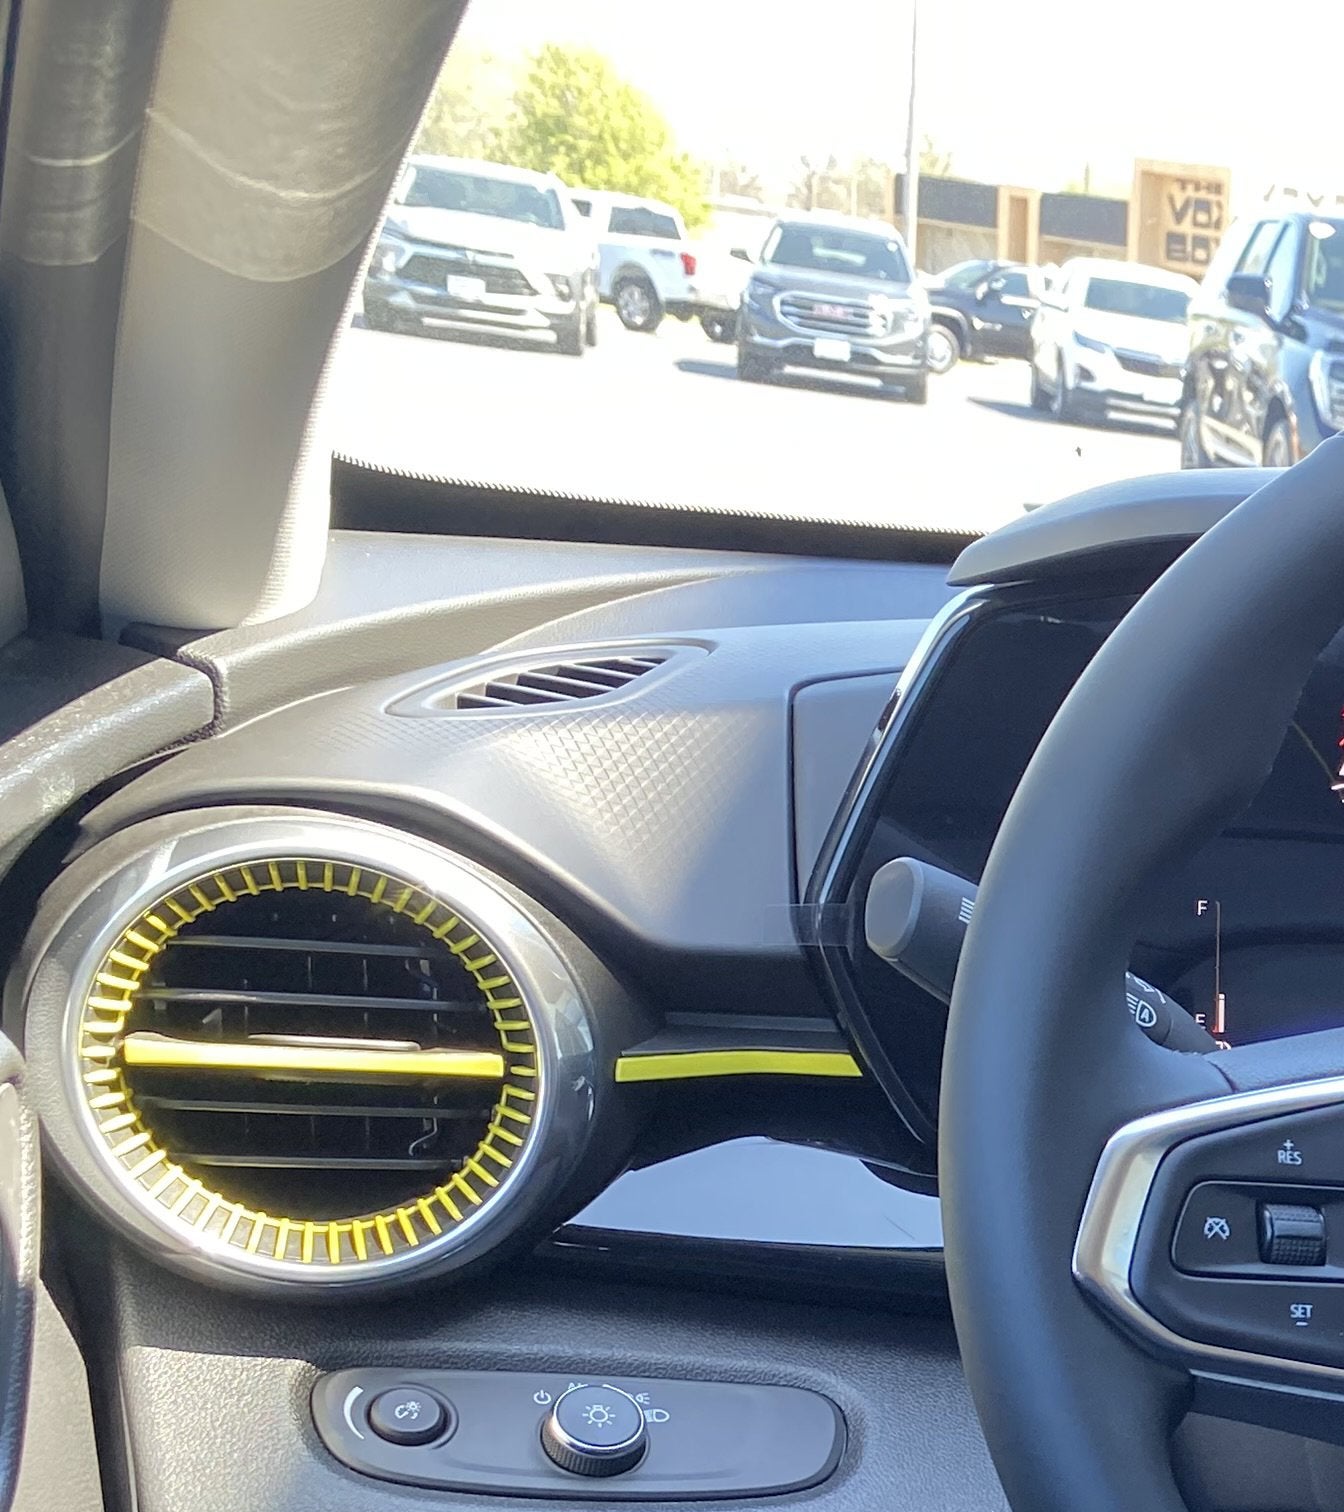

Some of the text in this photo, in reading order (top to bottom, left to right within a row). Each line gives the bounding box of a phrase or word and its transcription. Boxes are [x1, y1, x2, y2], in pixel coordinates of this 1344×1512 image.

[1167, 231, 1221, 264] BO
[1197, 900, 1208, 915] F
[1277, 1149, 1302, 1165] RES
[1290, 1304, 1313, 1318] SET
